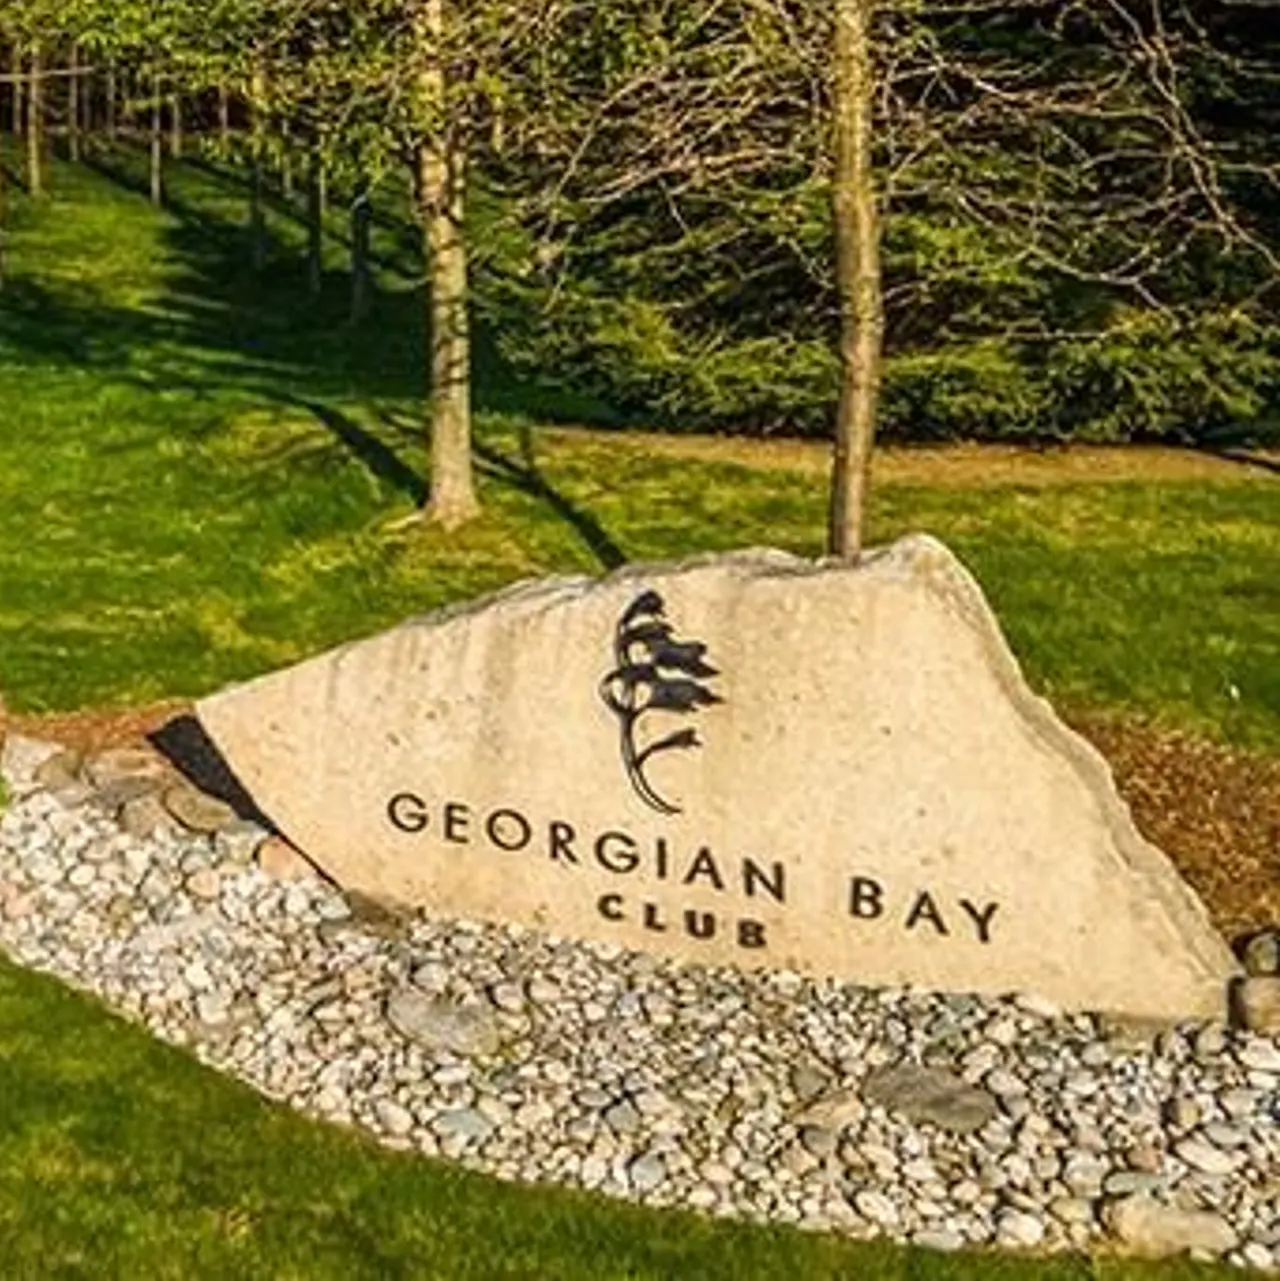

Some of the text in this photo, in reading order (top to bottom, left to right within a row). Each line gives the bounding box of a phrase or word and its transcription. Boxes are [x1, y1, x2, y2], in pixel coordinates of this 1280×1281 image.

[386, 792, 1001, 944] GEORGIAN BAY
[597, 893, 768, 948] CLUB
